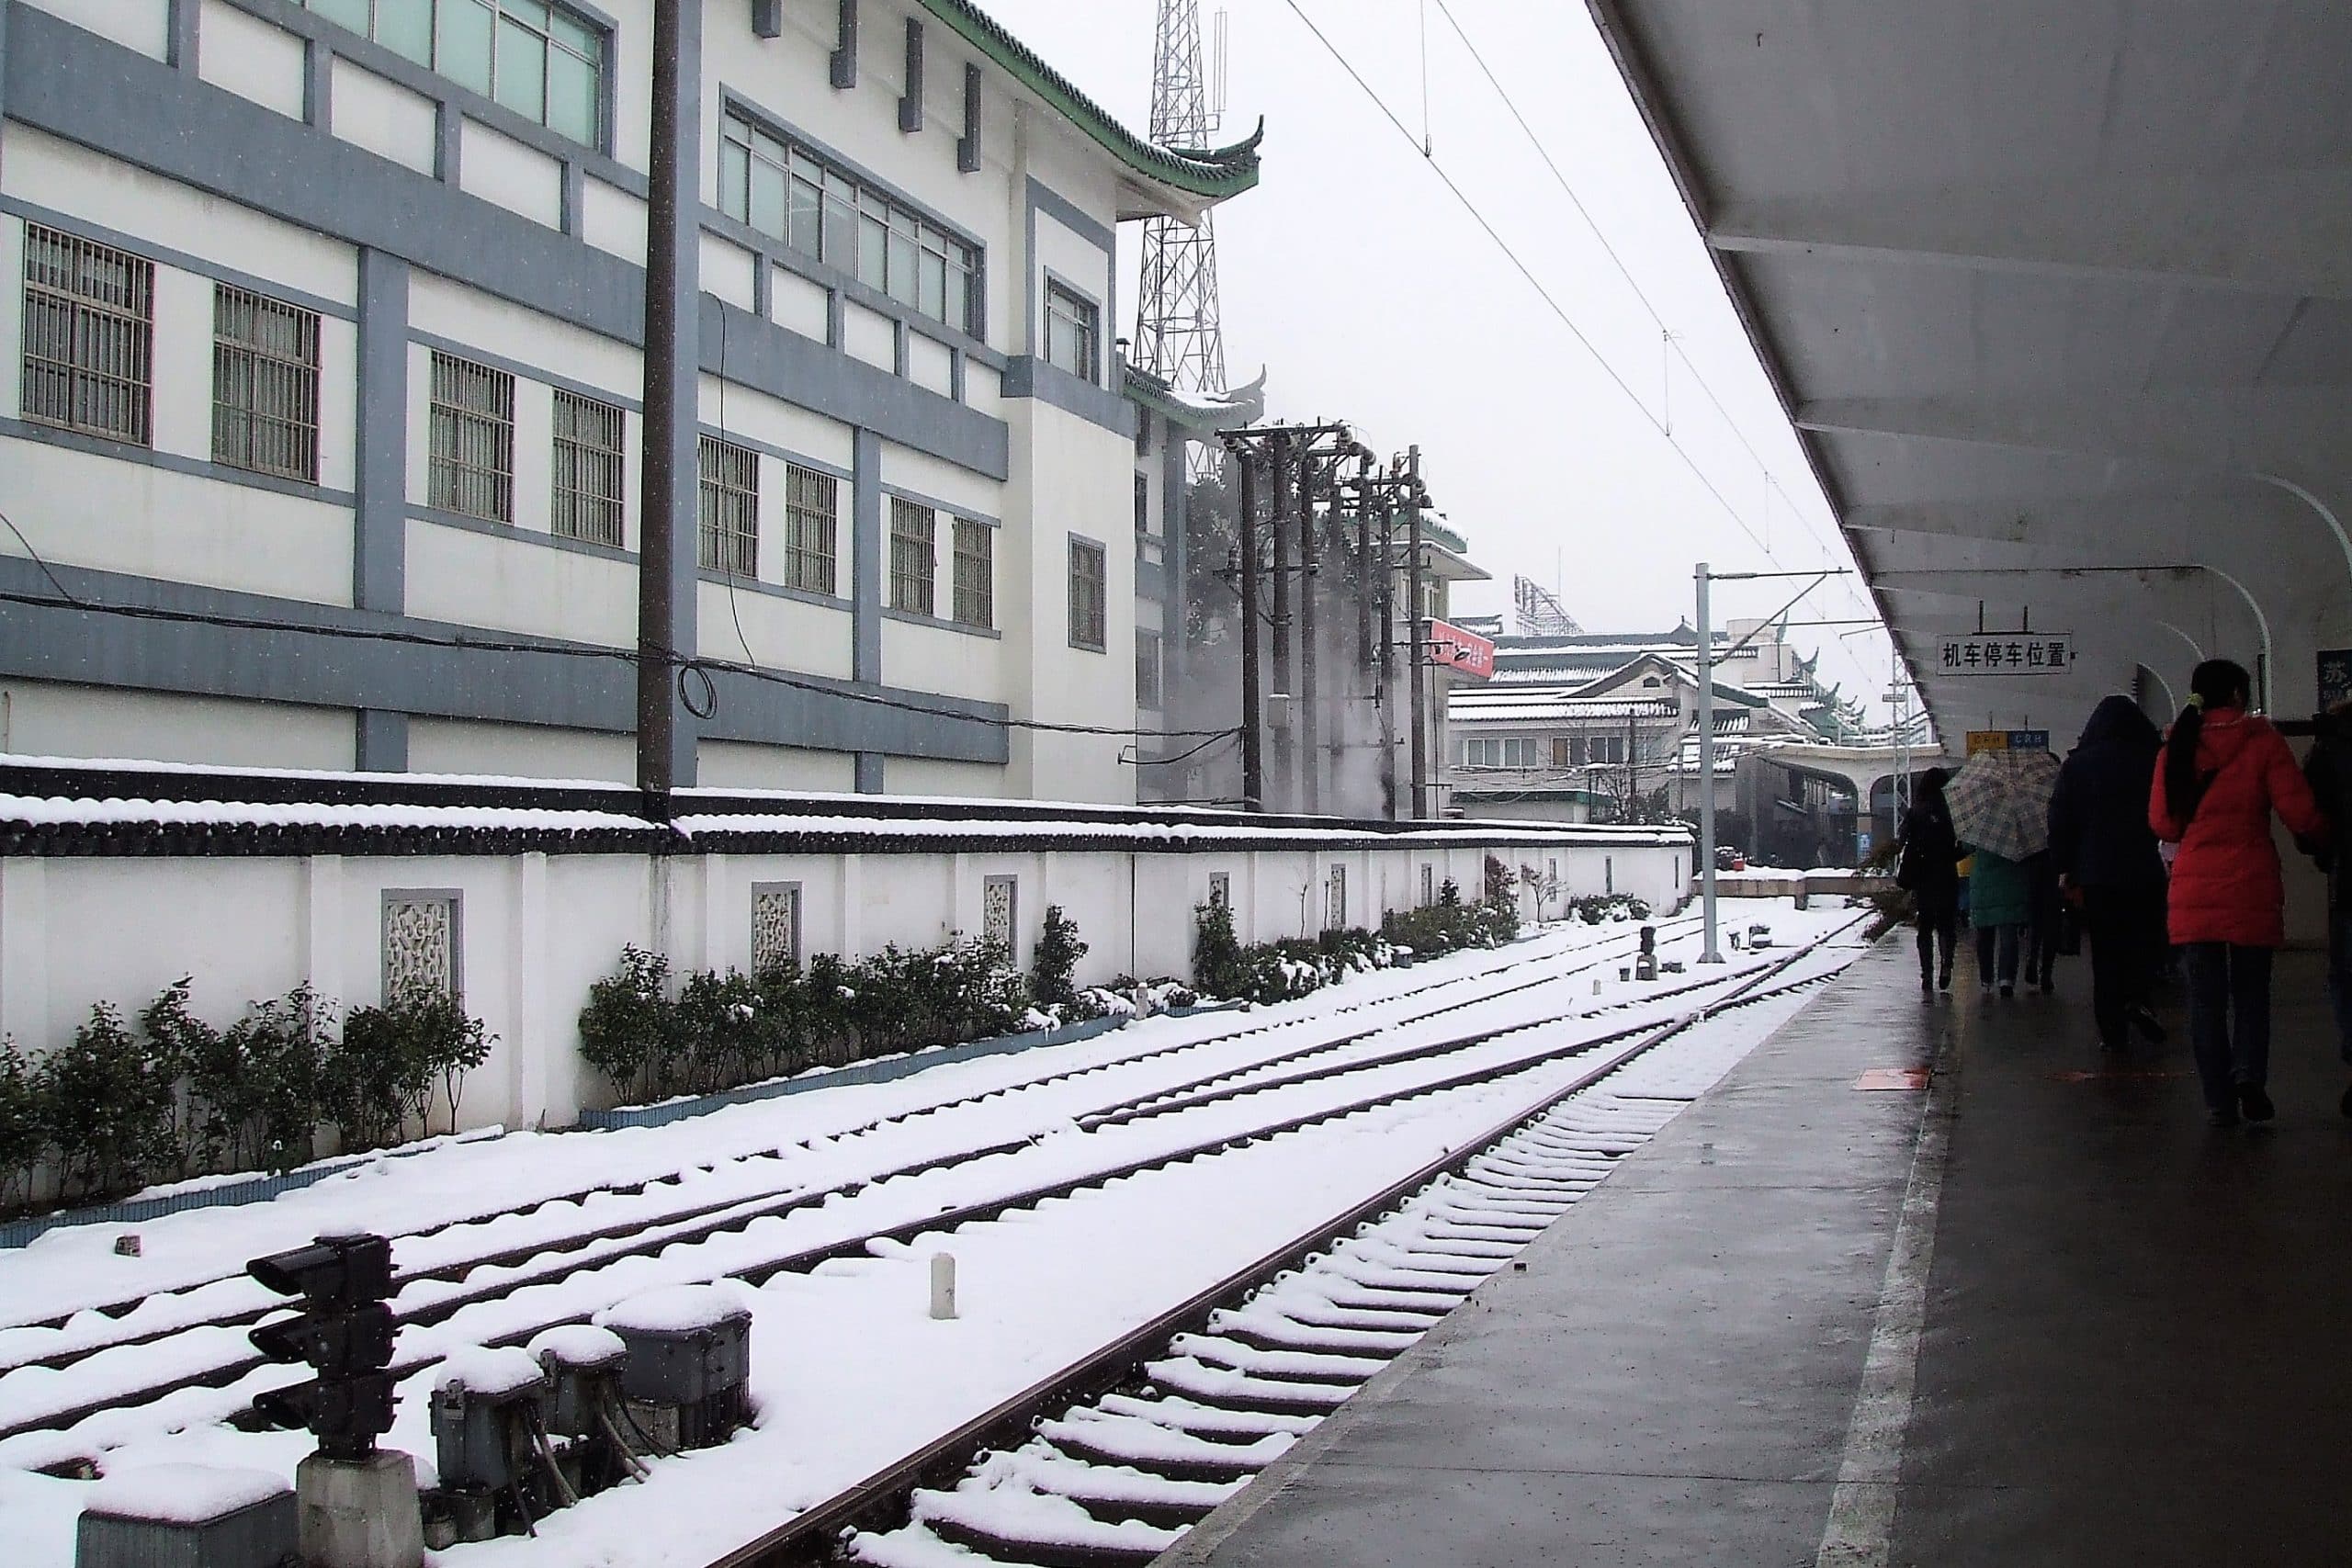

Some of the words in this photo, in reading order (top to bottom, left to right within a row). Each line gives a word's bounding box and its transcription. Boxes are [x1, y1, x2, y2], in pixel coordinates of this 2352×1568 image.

[1943, 642, 2065, 667] 机车停车位置
